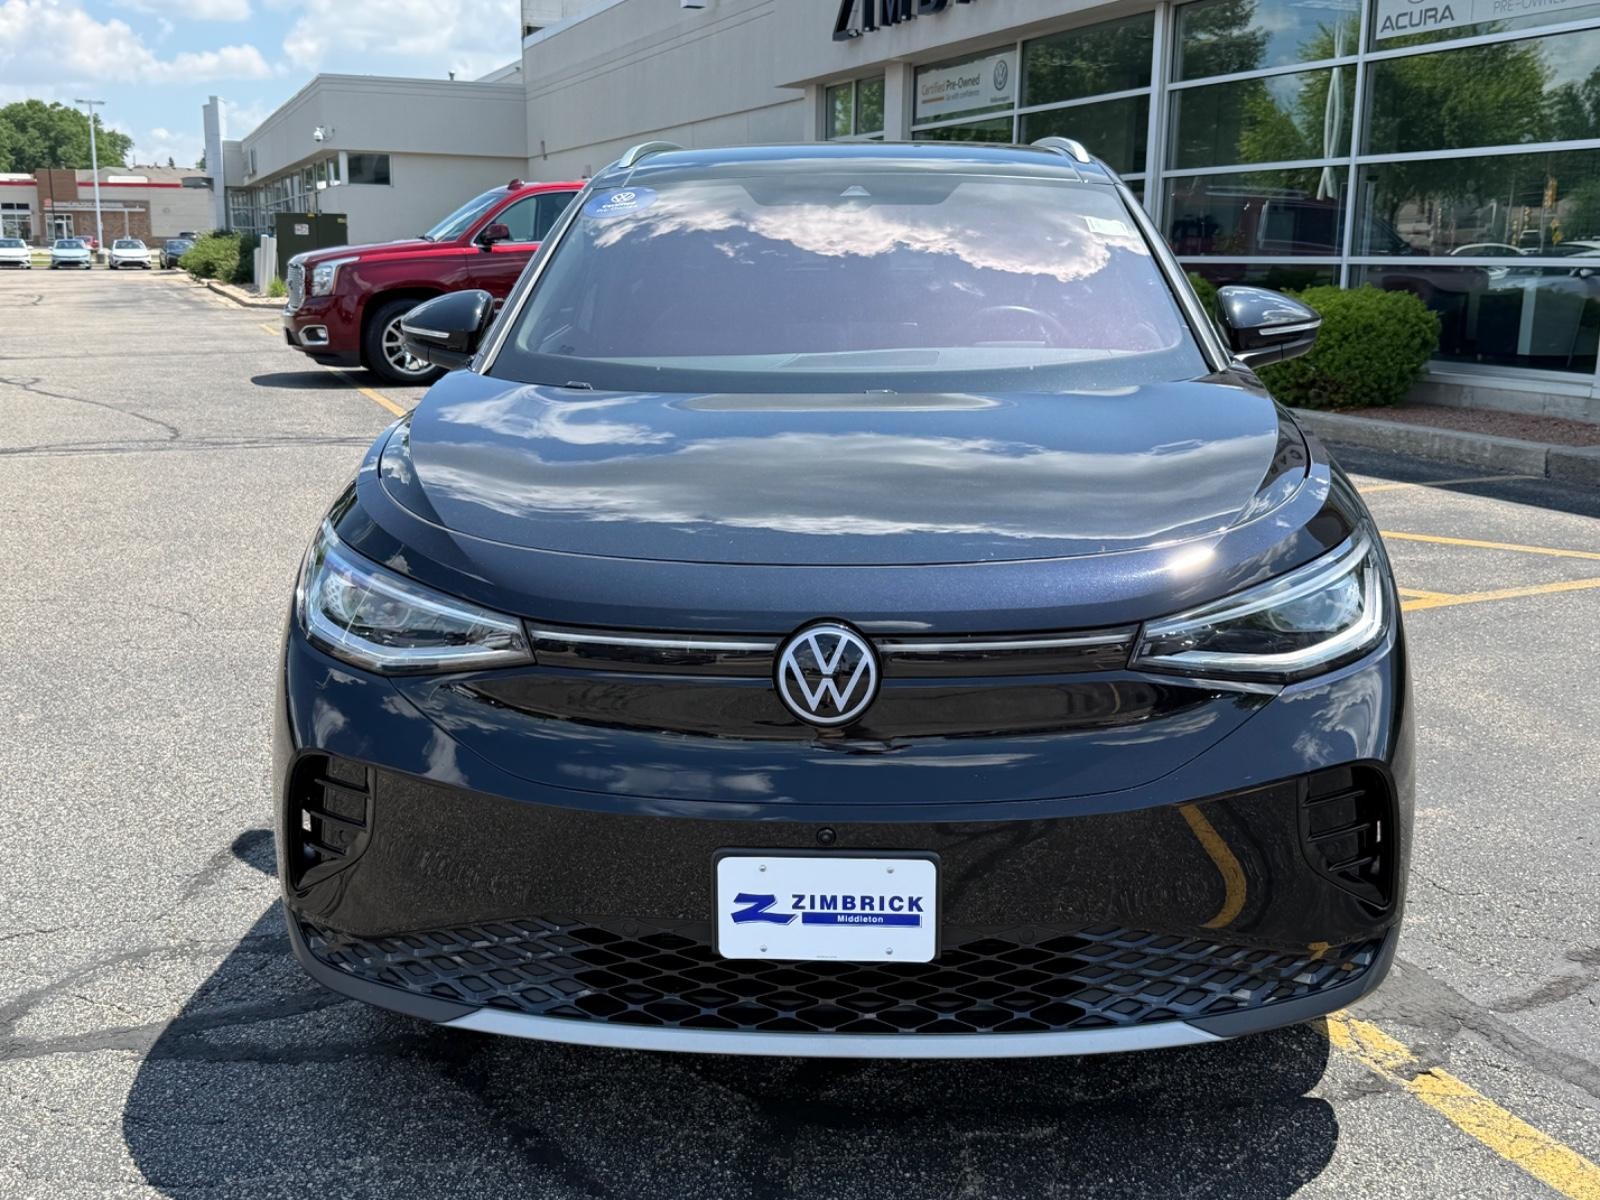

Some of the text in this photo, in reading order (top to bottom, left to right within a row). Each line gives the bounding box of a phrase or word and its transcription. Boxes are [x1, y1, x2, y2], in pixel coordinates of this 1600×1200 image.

[1380, 5, 1455, 33] ACURA
[791, 894, 924, 912] ZIMBRICK
[837, 914, 884, 923] Middleton
